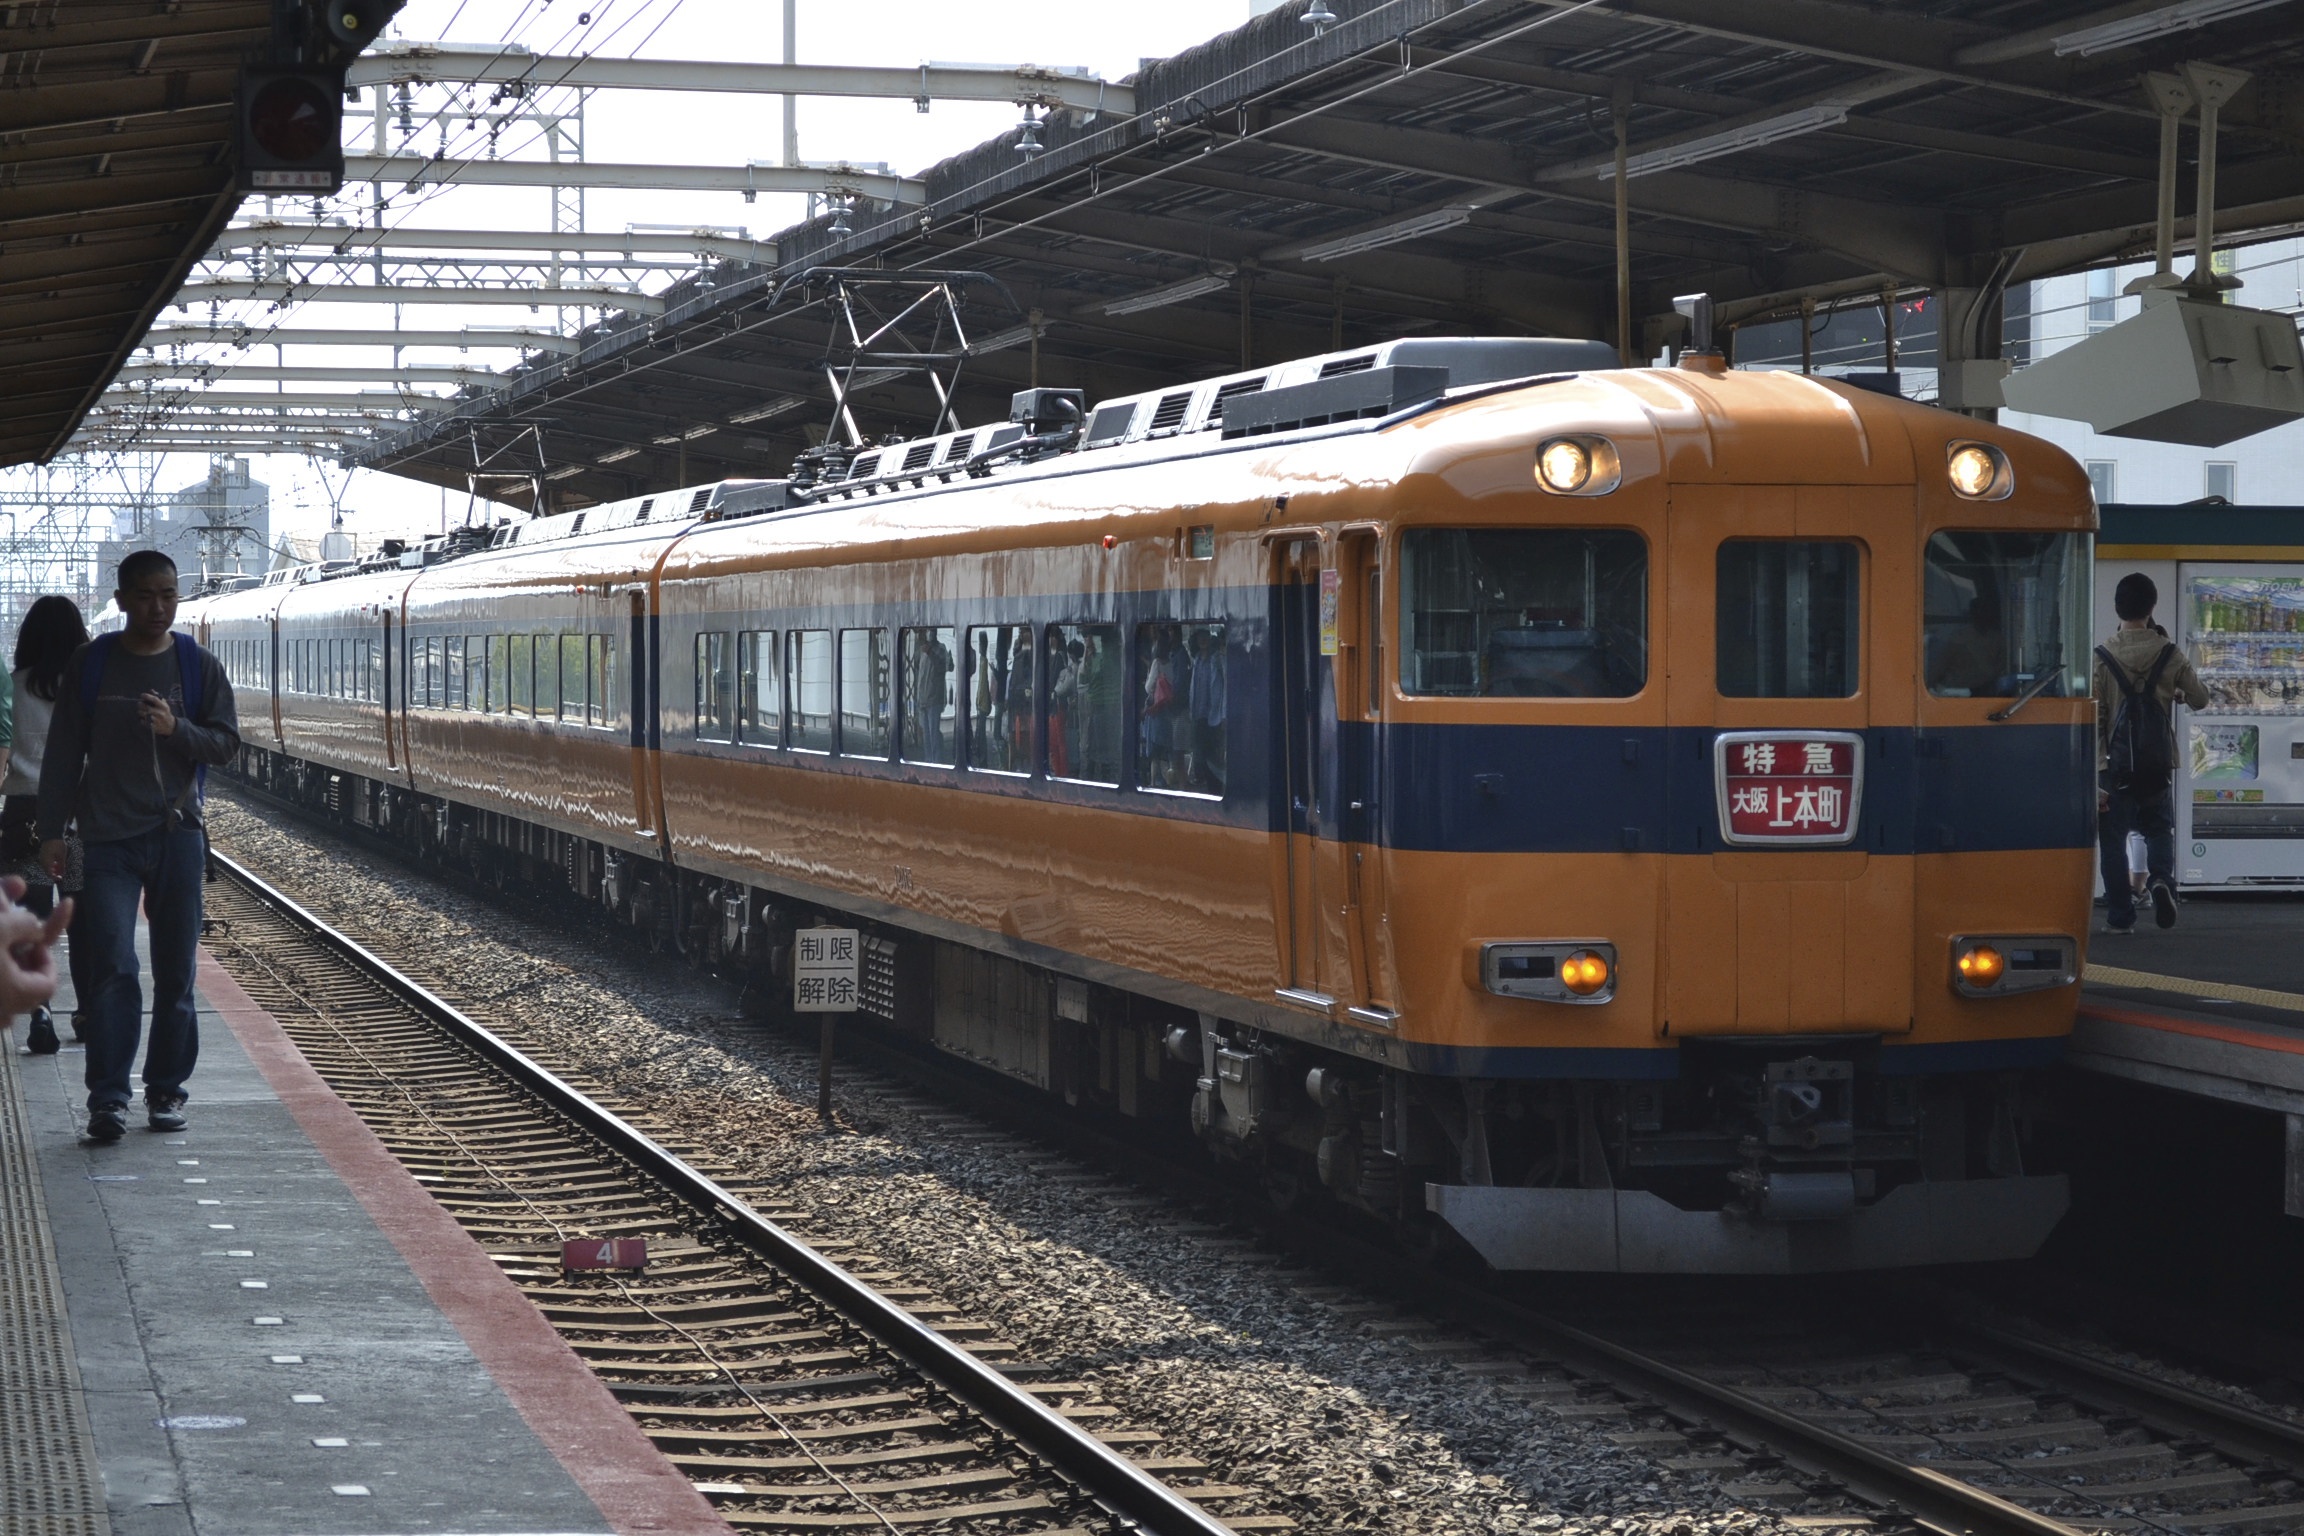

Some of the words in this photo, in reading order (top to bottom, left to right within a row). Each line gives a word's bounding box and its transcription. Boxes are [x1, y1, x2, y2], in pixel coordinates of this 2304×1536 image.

[2281, 582, 2297, 591] EN
[1742, 743, 1834, 774] 特急
[800, 936, 854, 961] 制限
[798, 976, 855, 1004] 解除
[596, 1242, 612, 1264] 4
